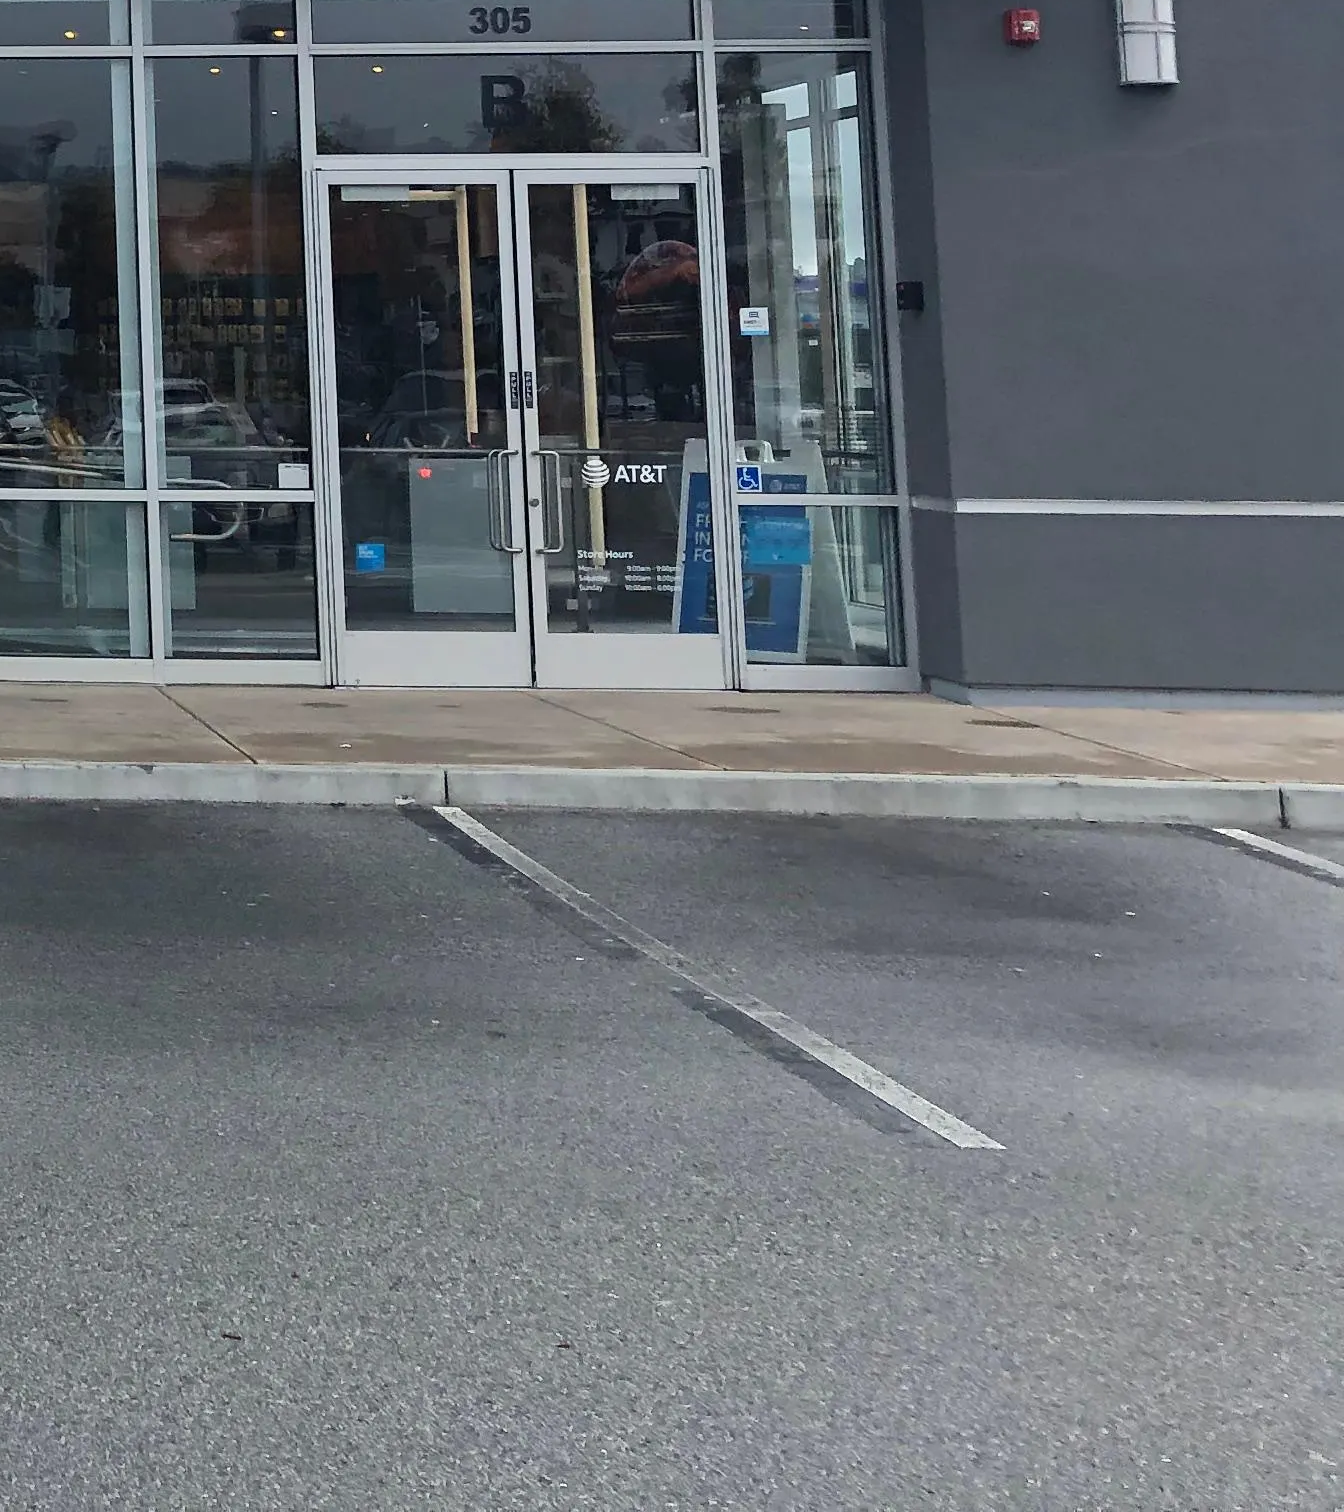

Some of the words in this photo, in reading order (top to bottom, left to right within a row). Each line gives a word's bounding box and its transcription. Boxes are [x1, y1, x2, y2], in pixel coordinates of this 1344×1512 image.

[469, 6, 532, 35] 305
[614, 464, 667, 483] AT&T
[577, 550, 604, 559] Store
[605, 550, 633, 559] Hours
